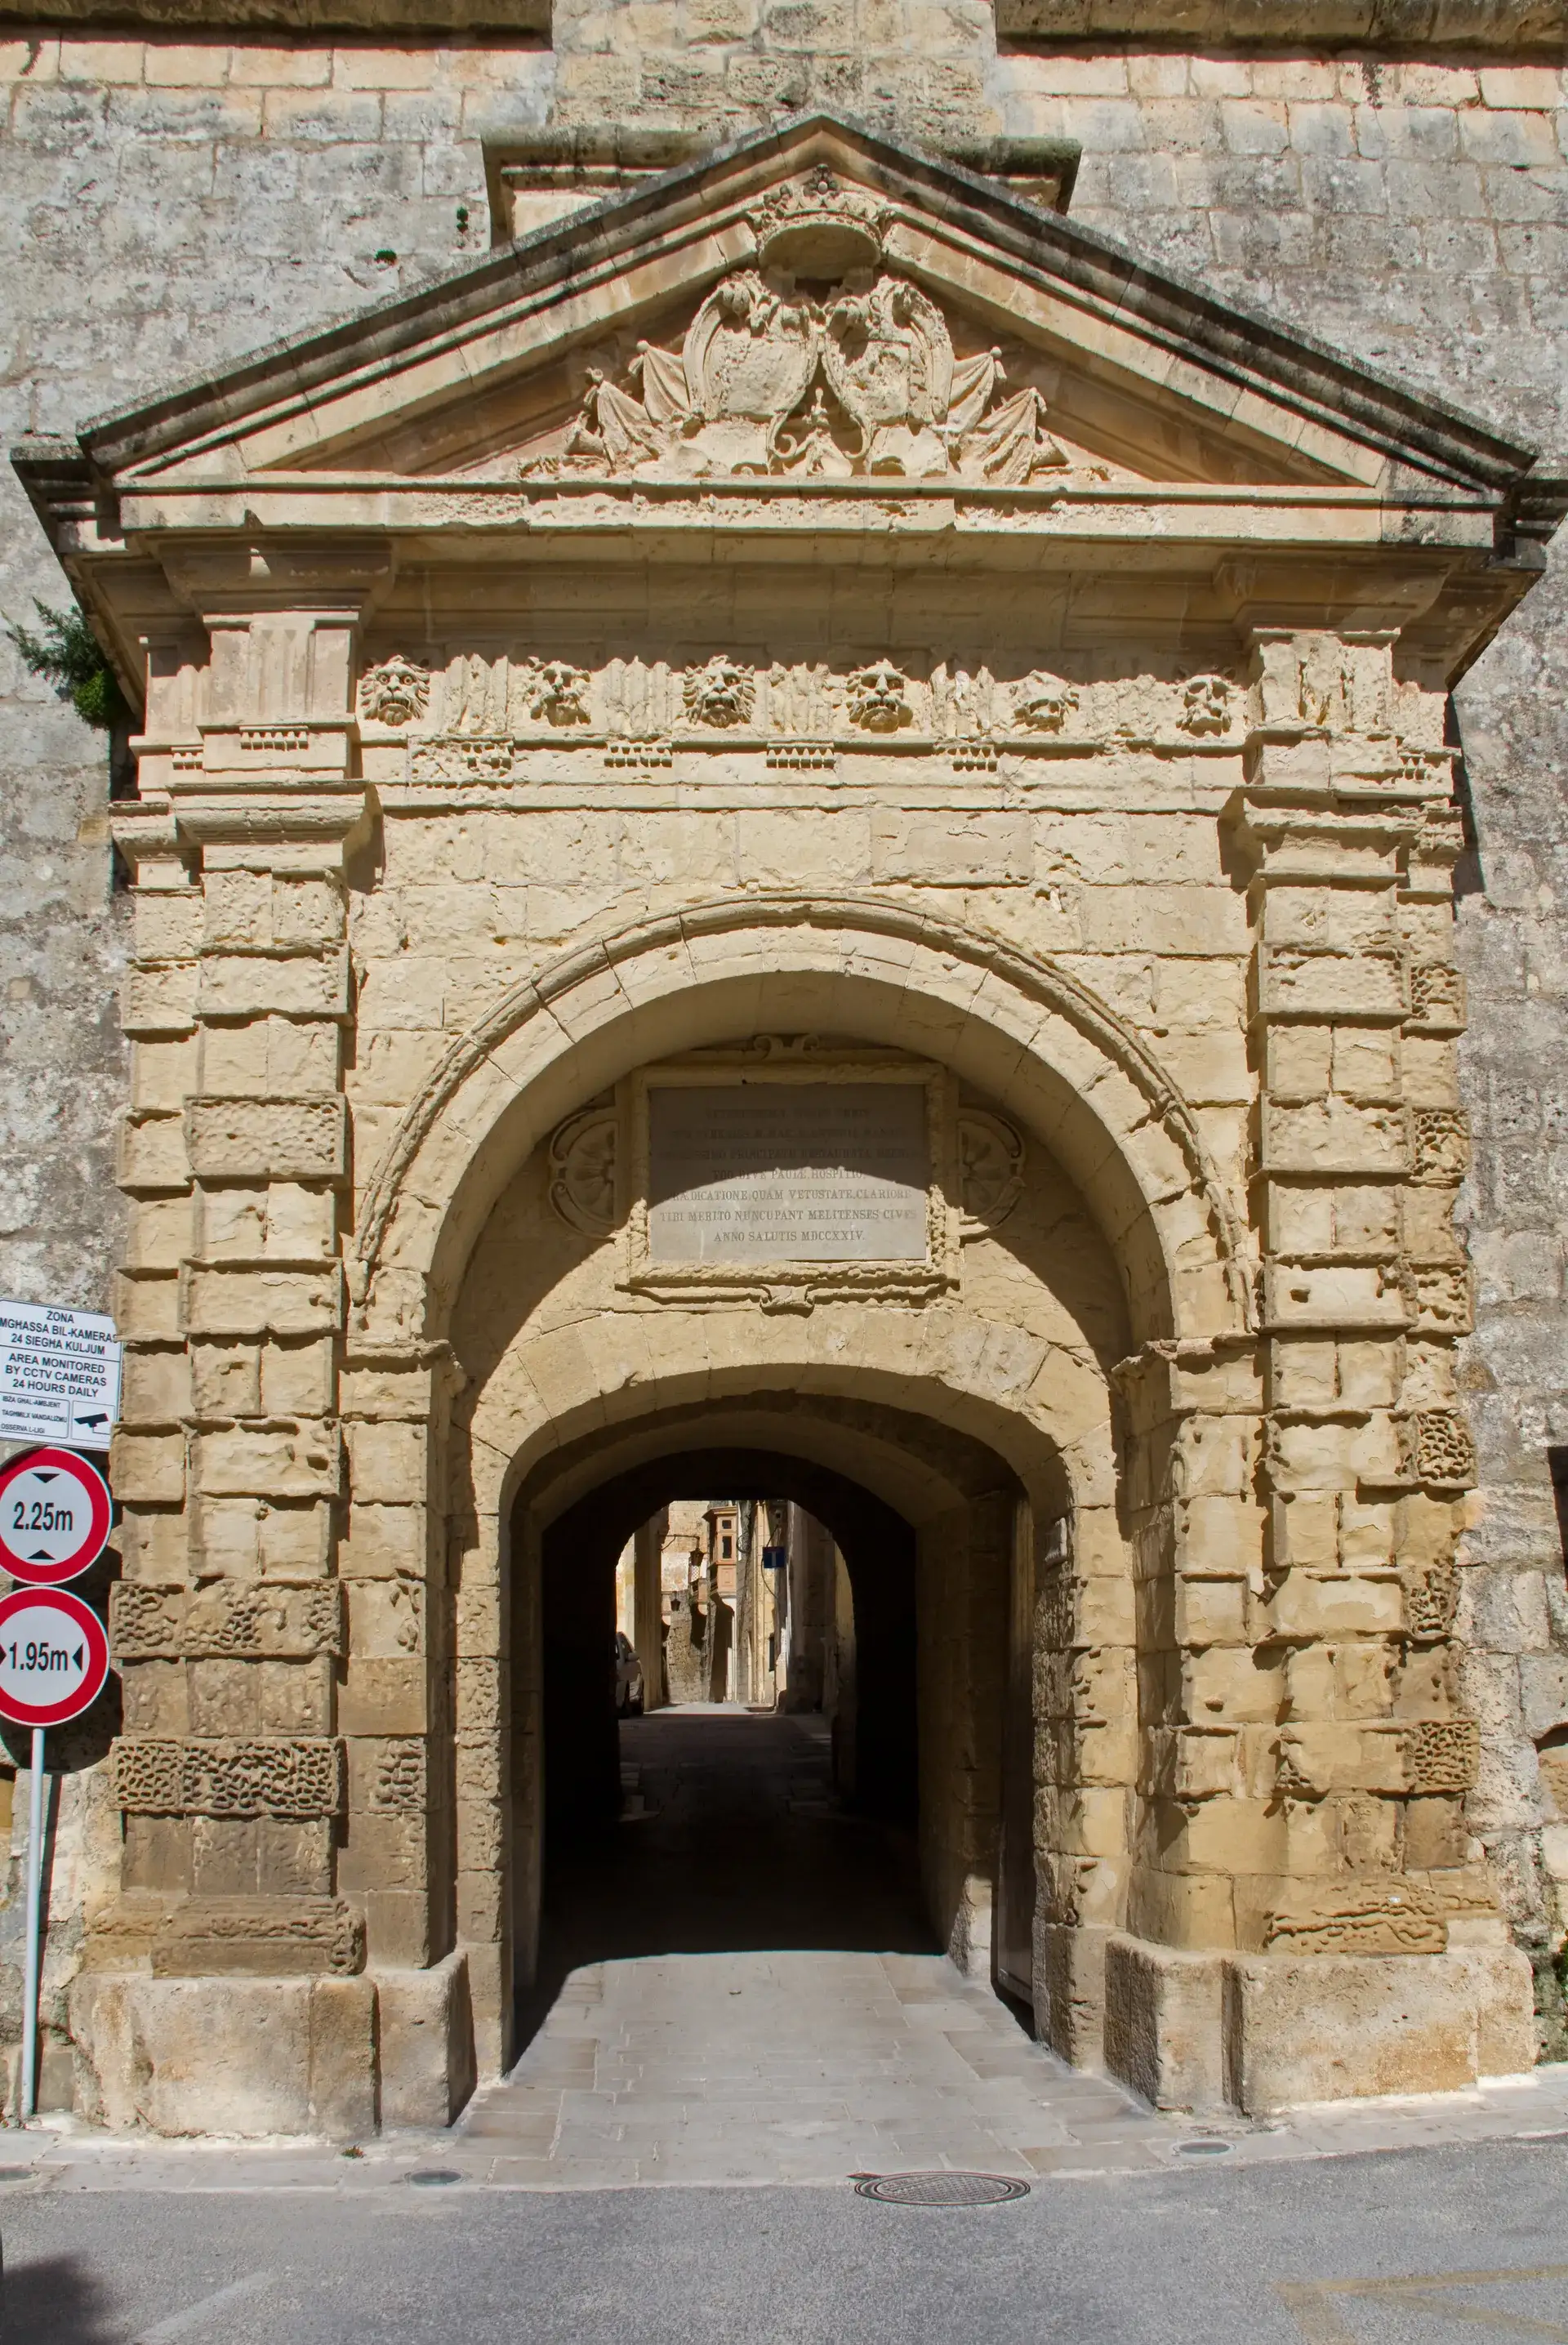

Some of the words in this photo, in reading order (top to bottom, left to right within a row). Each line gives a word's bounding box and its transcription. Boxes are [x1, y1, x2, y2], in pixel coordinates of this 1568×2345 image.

[752, 1189, 783, 1201] QUAM
[688, 1210, 731, 1221] MERITO
[734, 1210, 803, 1221] NUNCUPANT
[808, 1209, 879, 1220] MELITENSES
[883, 1209, 917, 1219] CIVES
[714, 1232, 745, 1242] ANNO
[749, 1231, 797, 1242] SALUTIS
[46, 1310, 75, 1323] ZONA
[11, 1333, 23, 1344] 24
[25, 1335, 63, 1349] SIEGHA
[65, 1340, 105, 1355] KULJUM
[8, 1353, 40, 1366] AREA
[42, 1358, 105, 1374] MONITORED
[5, 1365, 21, 1375] BY
[23, 1367, 53, 1380] CCTV
[55, 1371, 107, 1387] CAMERAS
[12, 1379, 26, 1389] 24
[28, 1380, 66, 1394] HOURS
[68, 1385, 99, 1398] DAILY
[13, 1500, 74, 1531] 2.25m
[9, 1641, 69, 1672] 1.95m
